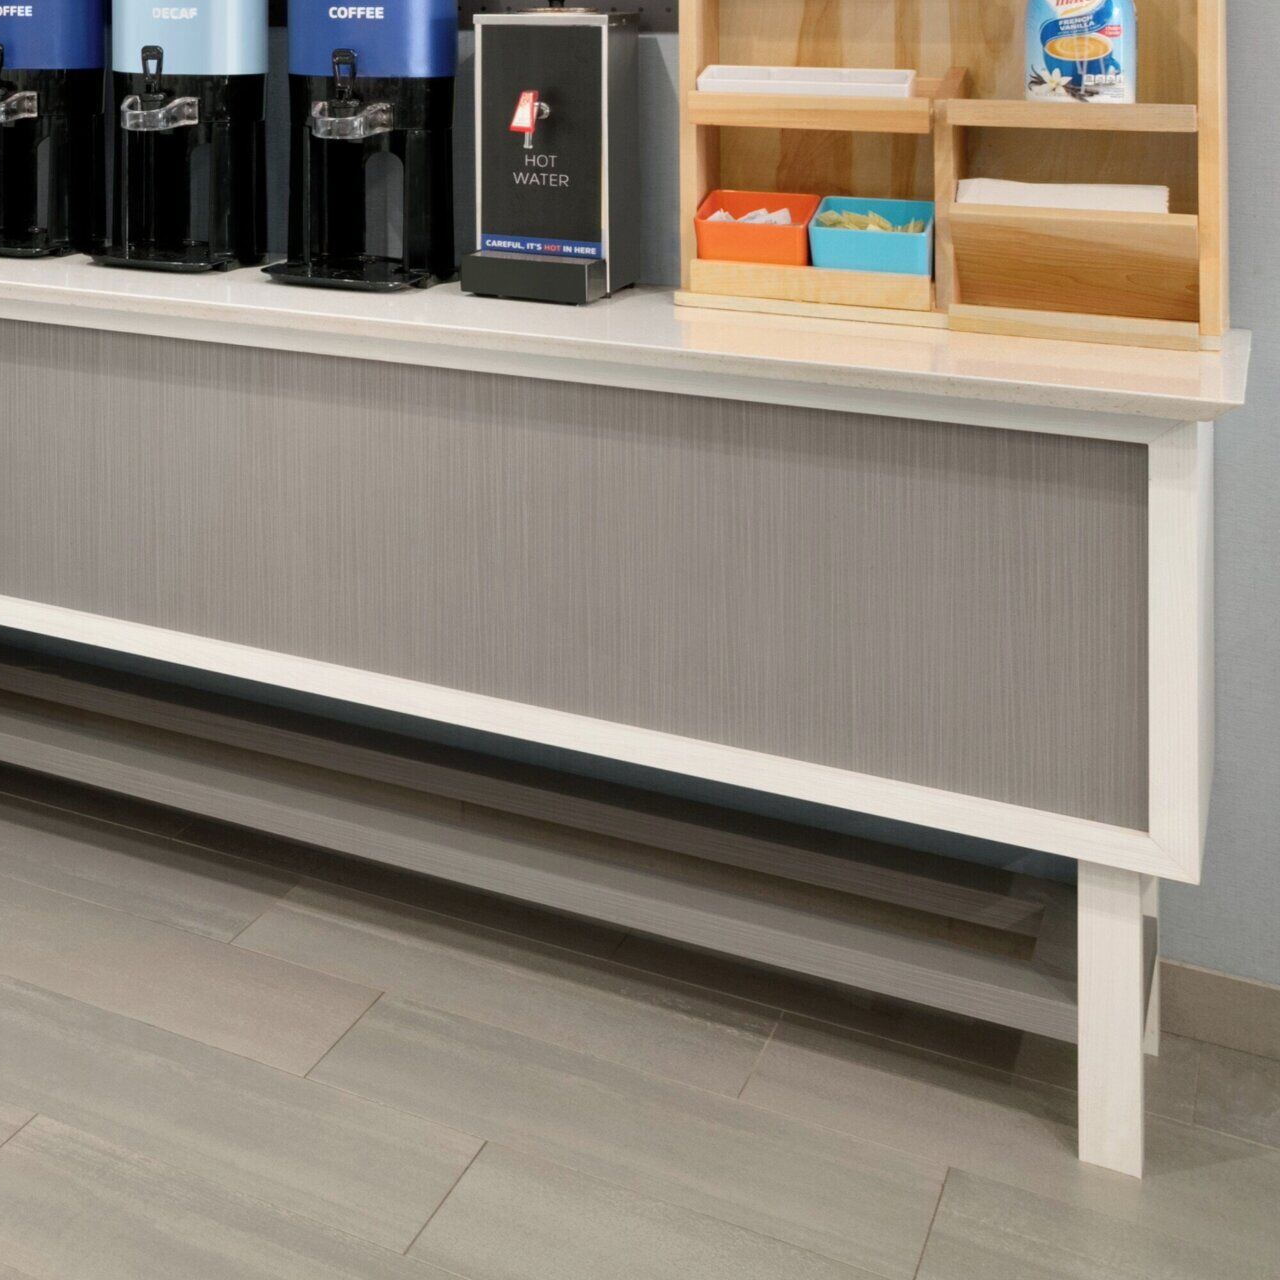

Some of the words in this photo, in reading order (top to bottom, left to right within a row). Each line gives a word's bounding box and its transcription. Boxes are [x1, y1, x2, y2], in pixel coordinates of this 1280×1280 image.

[152, 7, 198, 20] DECAF
[329, 6, 384, 19] COFFEE
[1058, 15, 1094, 26] FRENCH
[1060, 21, 1095, 31] VANILLA
[525, 154, 558, 168] HOT
[512, 172, 570, 187] WATER
[527, 242, 542, 251] IT'S
[544, 243, 561, 252] HOT
[563, 245, 573, 253] IN
[574, 246, 597, 255] HERE
